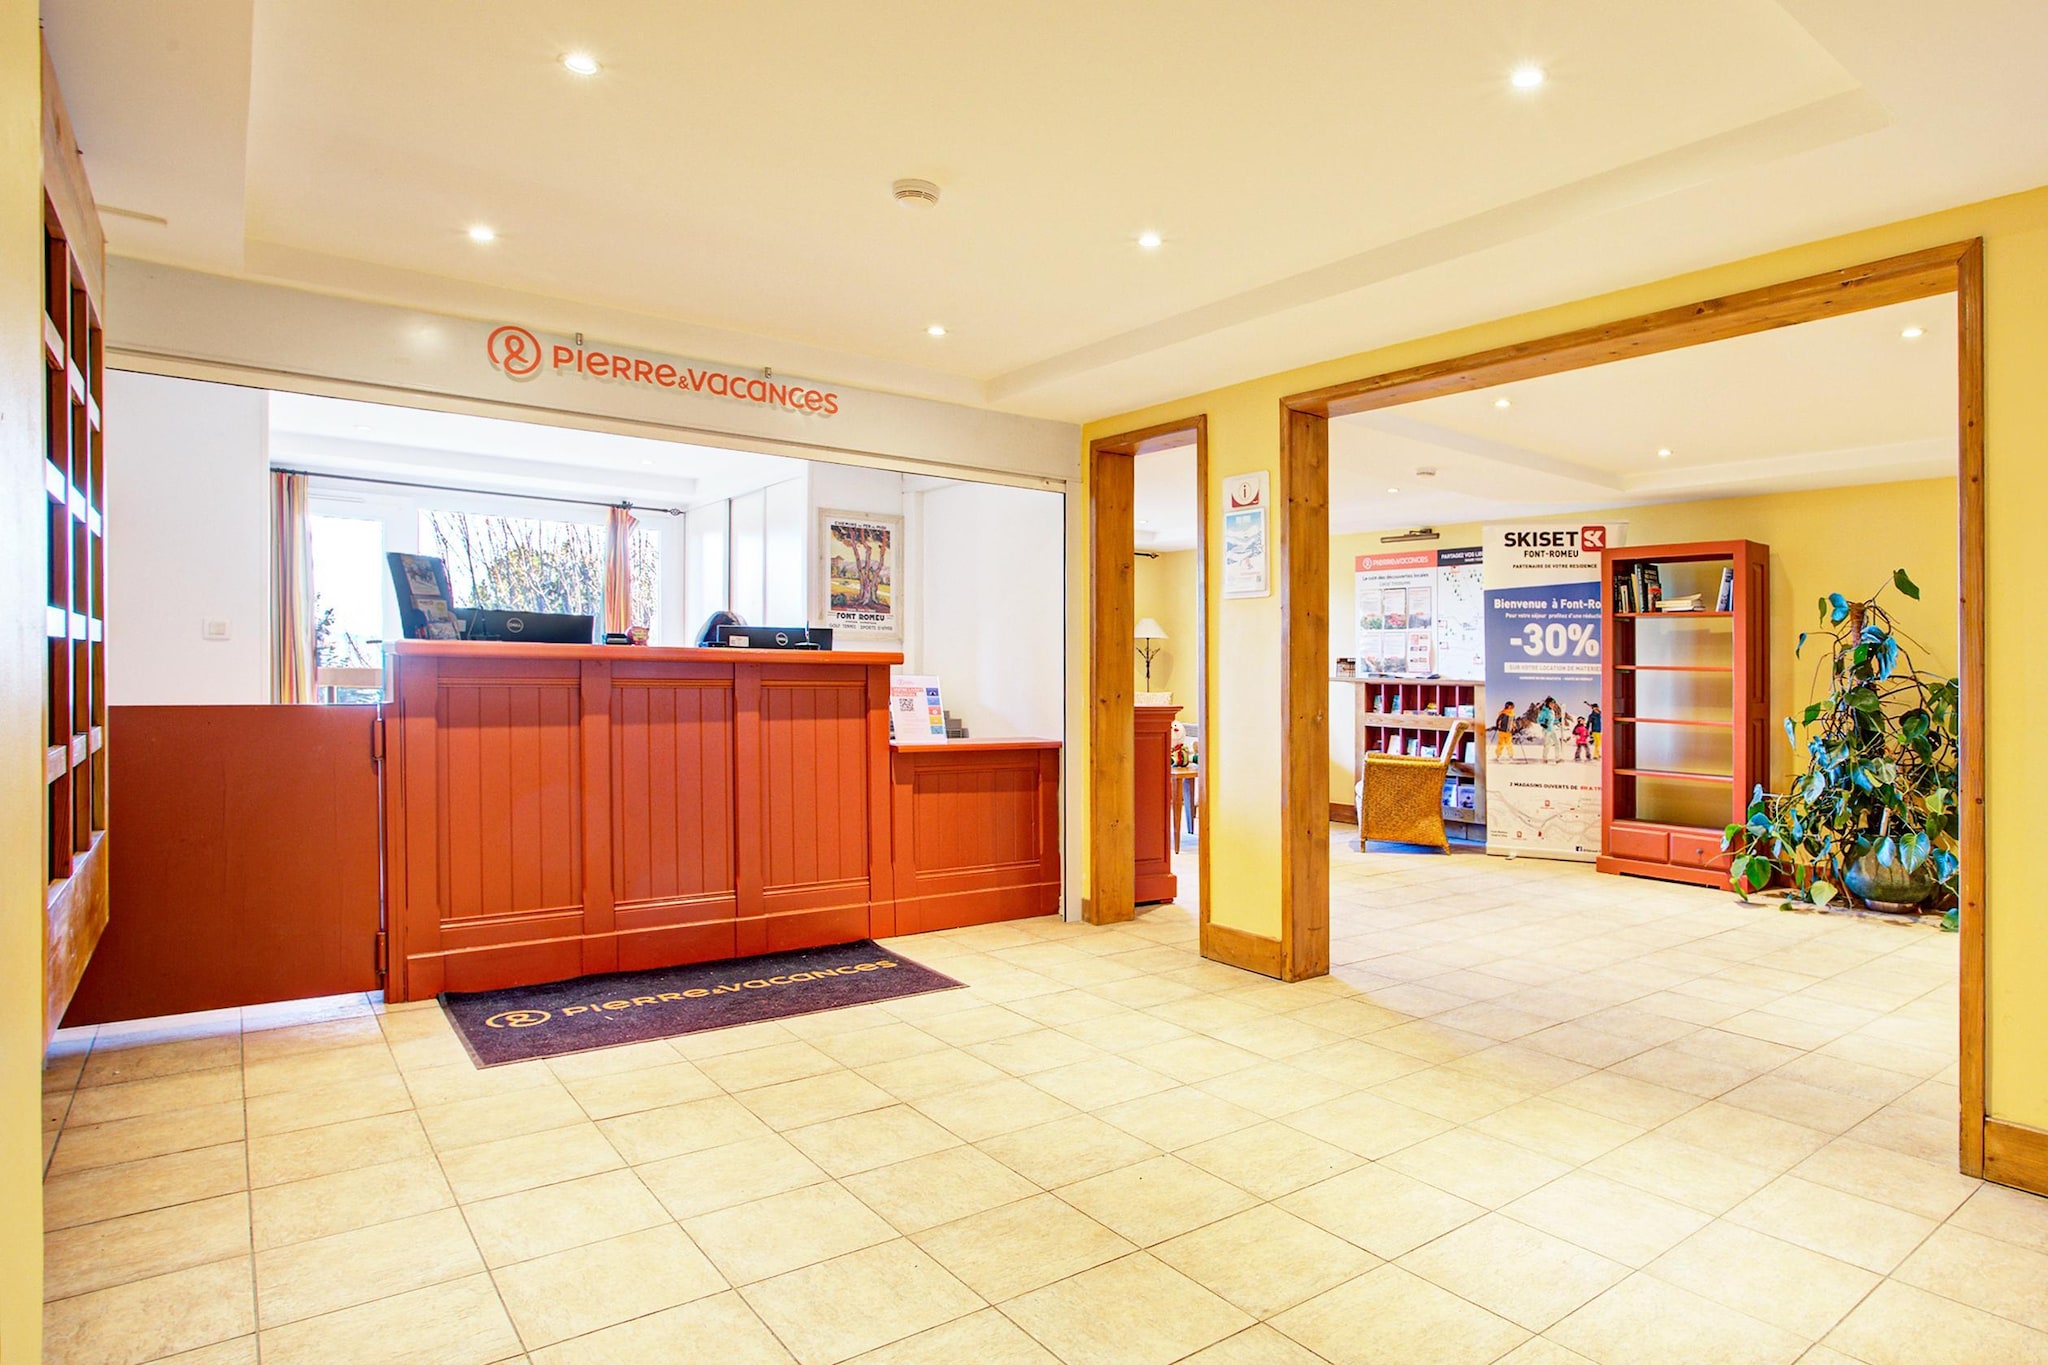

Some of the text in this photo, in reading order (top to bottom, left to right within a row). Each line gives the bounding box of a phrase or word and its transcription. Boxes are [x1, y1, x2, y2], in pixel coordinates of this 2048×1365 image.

[1503, 531, 1578, 548] SKISET
[1523, 550, 1579, 558] FONT-ROMEU
[1493, 598, 1548, 610] Bienvenue
[1551, 597, 1558, 609] à
[1510, 622, 1600, 657] -30%
